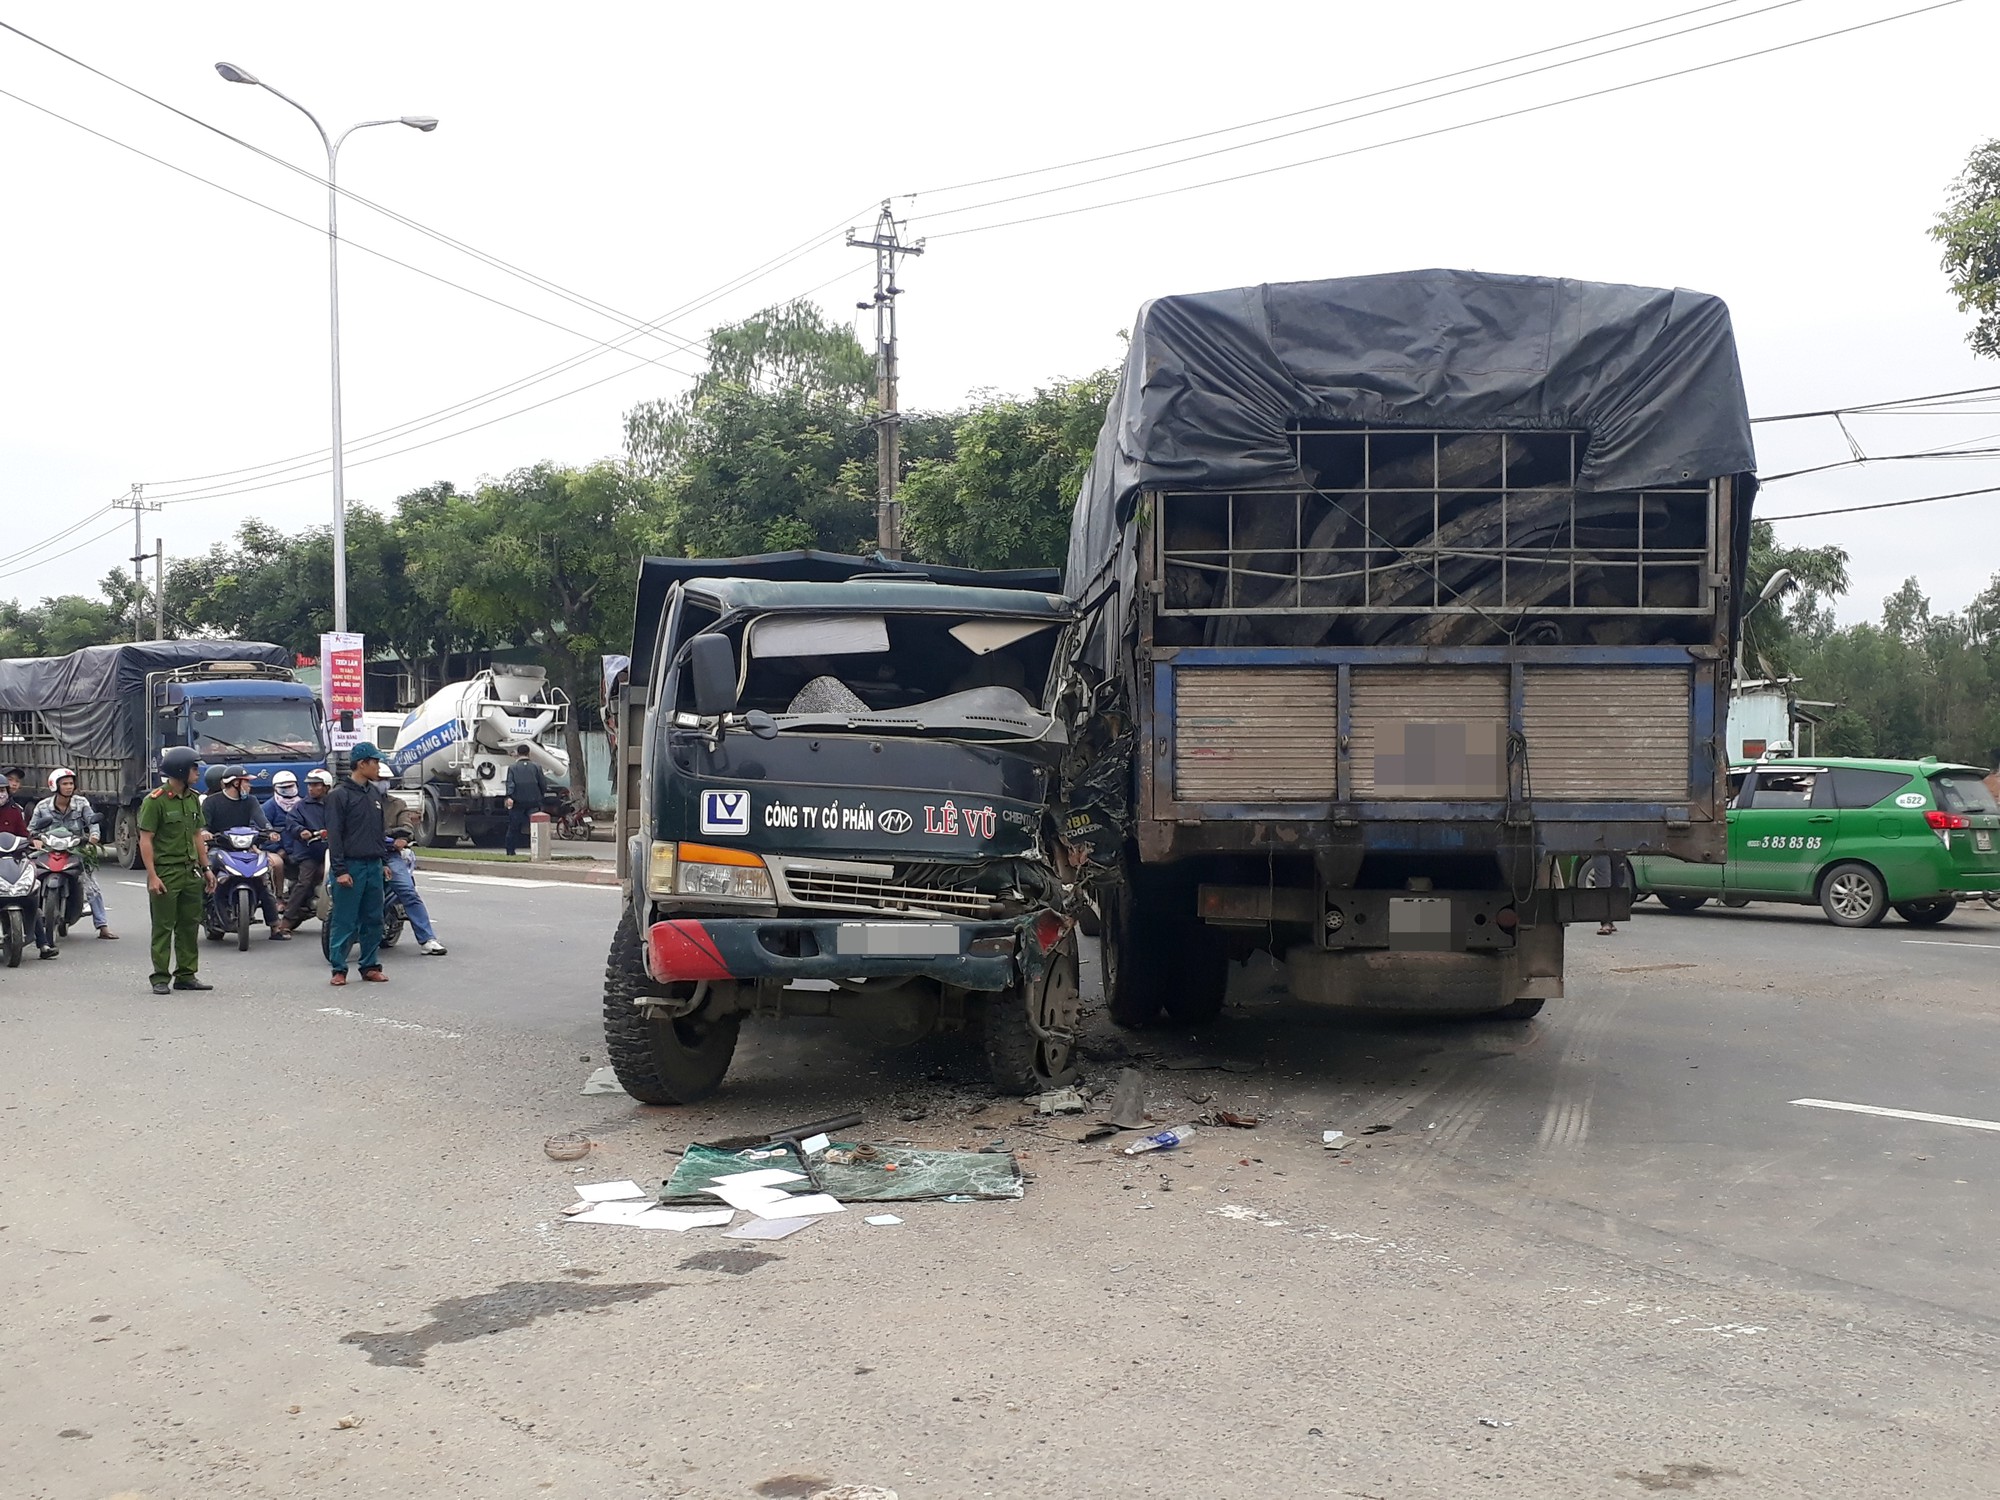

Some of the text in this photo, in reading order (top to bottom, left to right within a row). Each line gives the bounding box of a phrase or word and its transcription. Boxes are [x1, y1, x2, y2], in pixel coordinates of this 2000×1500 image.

[1906, 796, 1922, 804] 522
[765, 800, 874, 831] CÔNG TY CỔ PHẦN
[923, 800, 997, 839] LÊ VŨ
[1771, 836, 1786, 848] 83
[1788, 836, 1804, 849] 83
[1806, 836, 1822, 849] 83
